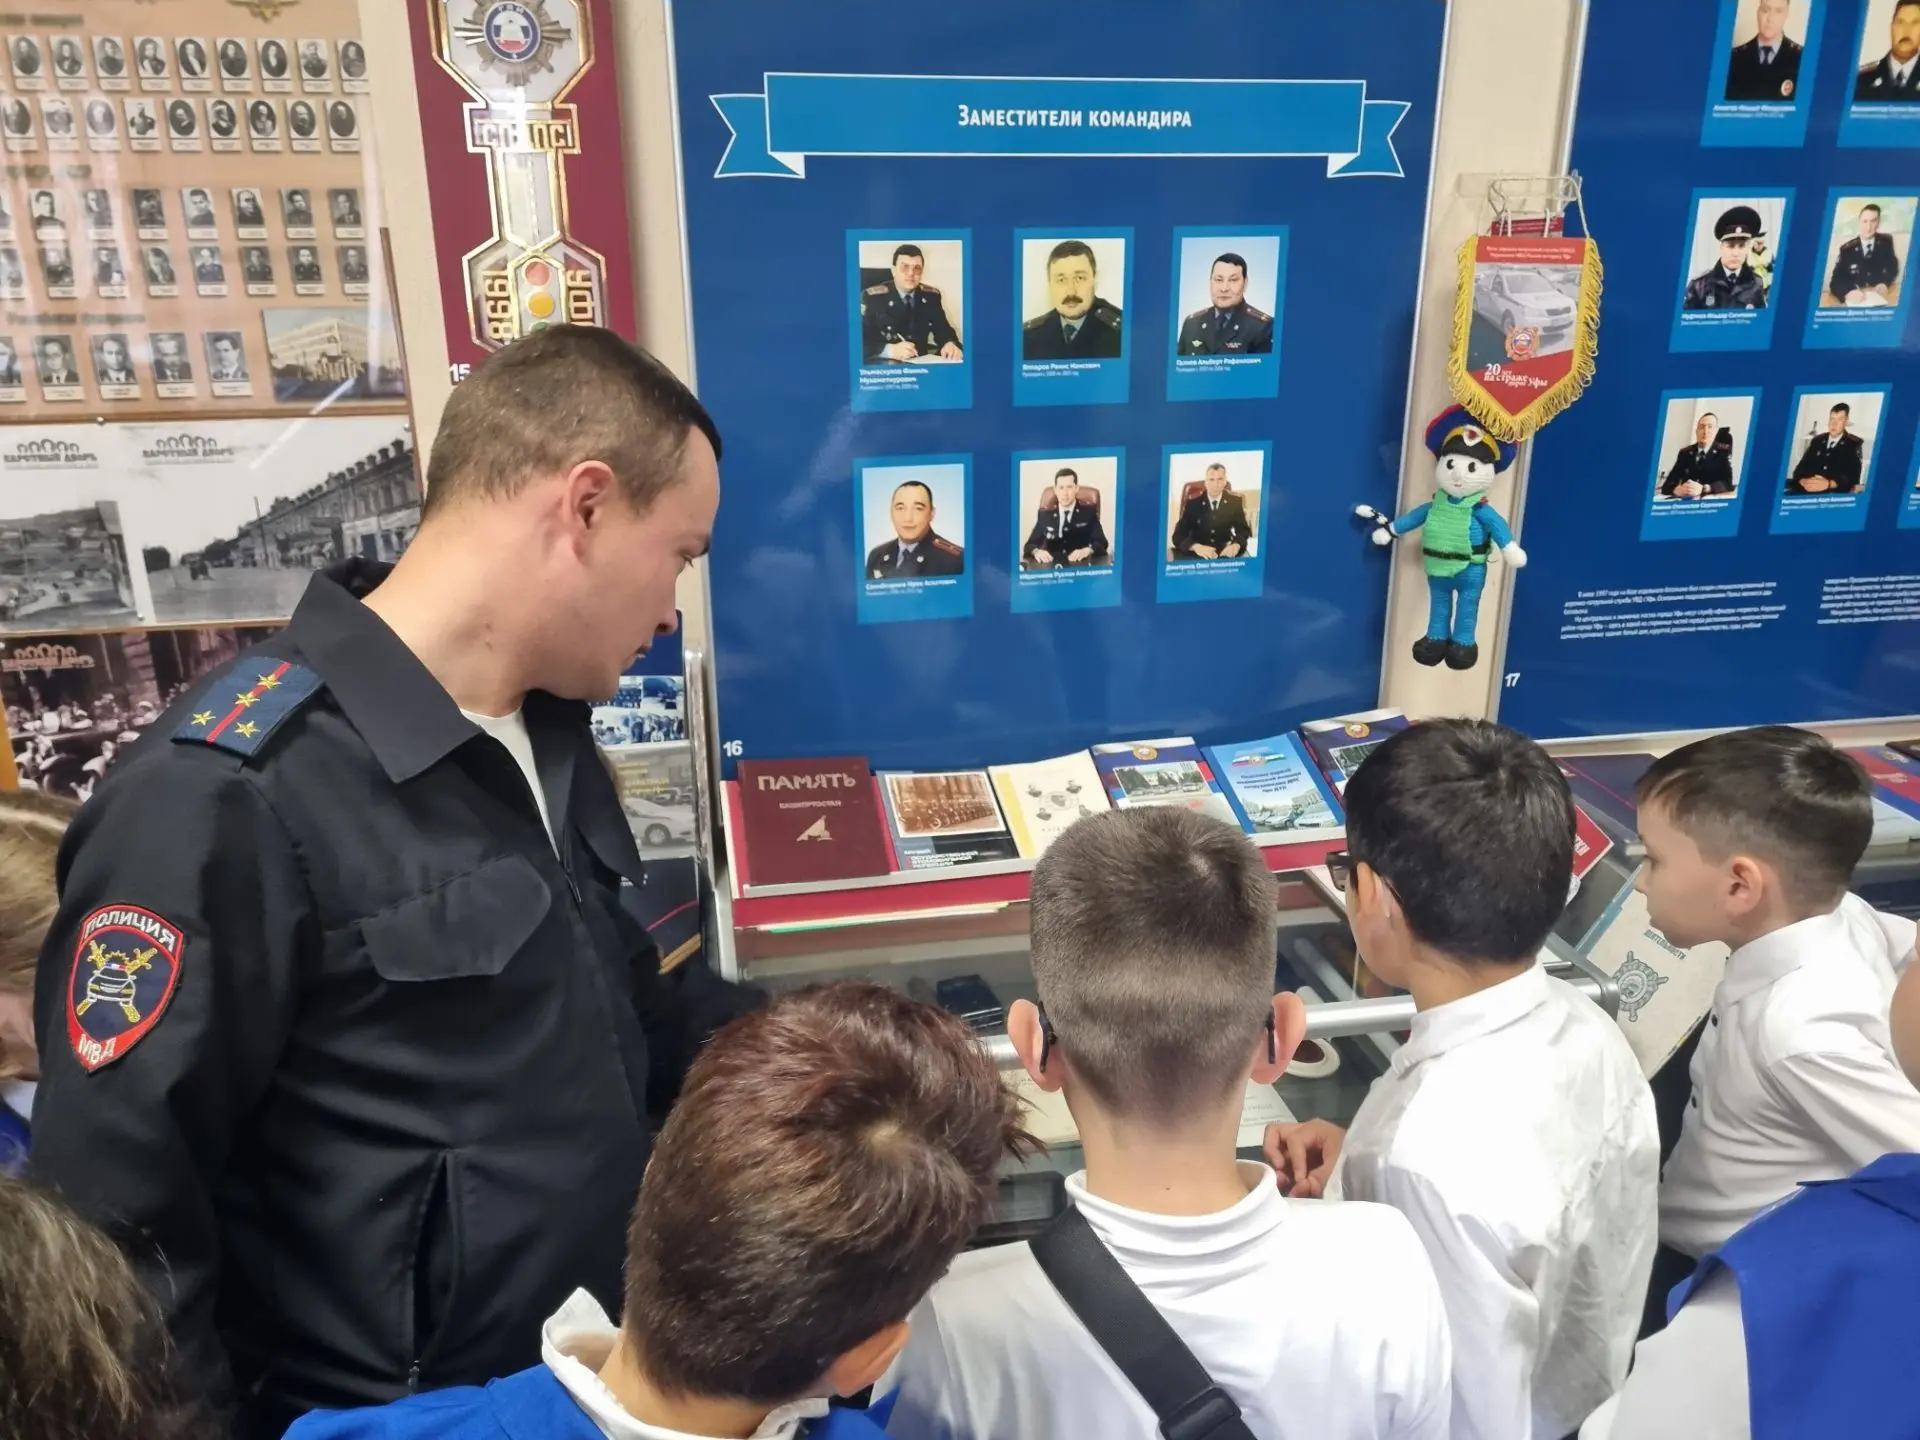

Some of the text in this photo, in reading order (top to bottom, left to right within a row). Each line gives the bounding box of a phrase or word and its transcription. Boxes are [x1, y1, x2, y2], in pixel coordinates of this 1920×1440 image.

[448, 362, 472, 382] 15
[1485, 363, 1501, 376] 20
[1505, 672, 1521, 687] 17
[723, 740, 743, 757] 16
[757, 772, 857, 791] ПАМЯТЬ
[83, 910, 177, 952] ПОЛИЦИЯ
[78, 1033, 116, 1064] МВД
